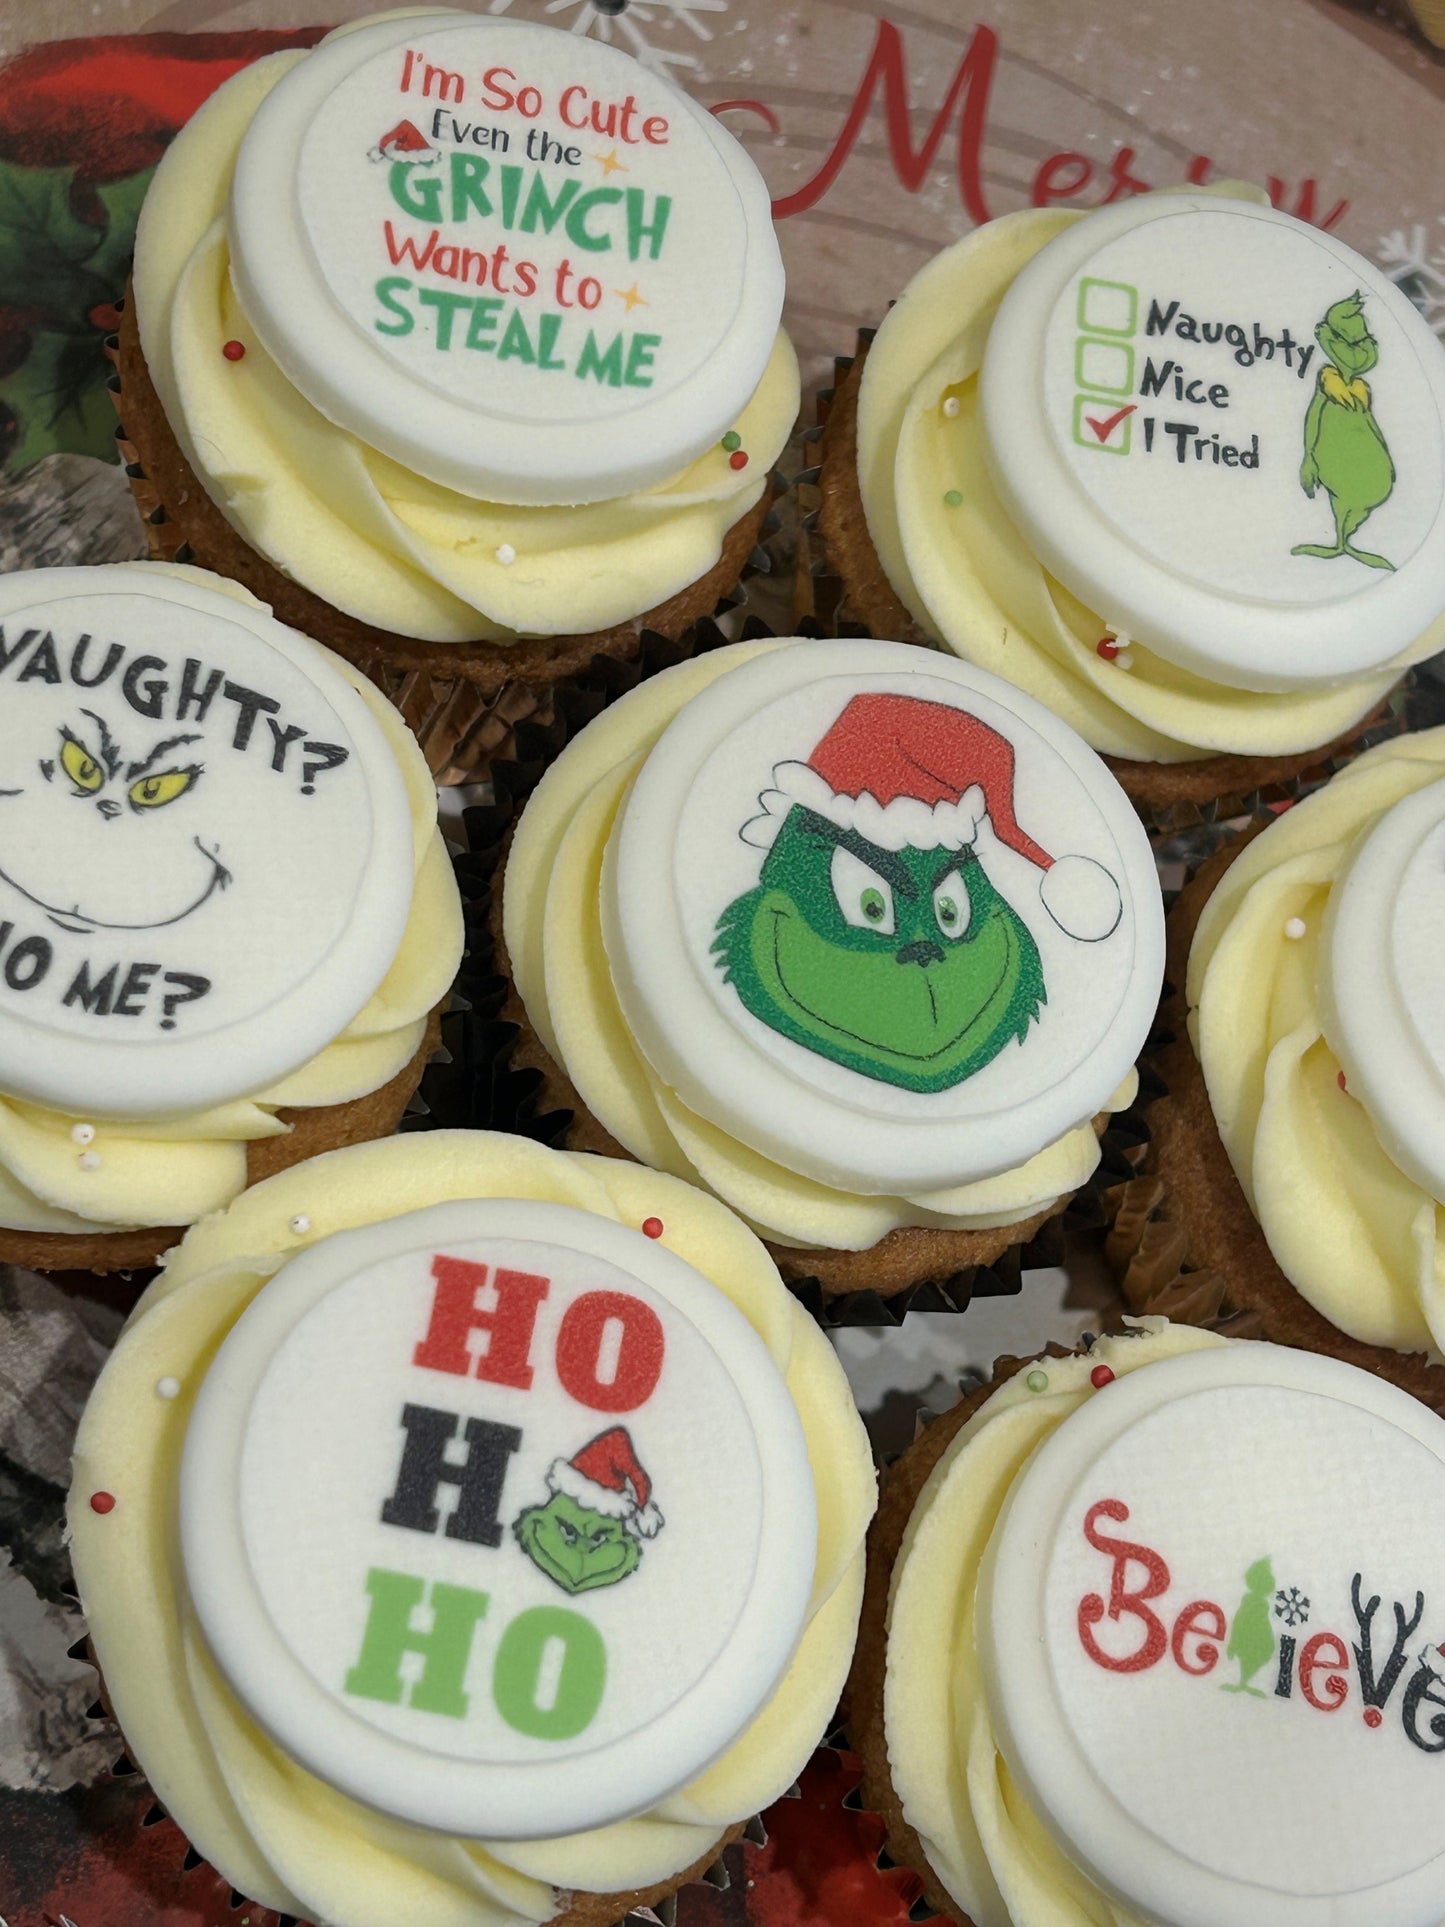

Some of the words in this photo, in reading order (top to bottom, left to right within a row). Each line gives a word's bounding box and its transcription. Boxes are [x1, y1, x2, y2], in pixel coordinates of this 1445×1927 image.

[400, 49, 464, 103] I'm
[481, 66, 543, 118] So
[558, 85, 670, 145] Cute
[431, 108, 510, 152] Even
[526, 128, 582, 166] the
[388, 151, 673, 263] GRINCH
[384, 219, 539, 298] Wants
[555, 258, 603, 310] to
[374, 276, 566, 370] STEAL
[575, 328, 663, 389] ME
[1145, 298, 1315, 379] Naughty
[1139, 356, 1230, 408] Nice
[1143, 417, 1156, 452] I
[1164, 421, 1260, 469] Tried
[62, 959, 212, 1030] ME?
[412, 1254, 665, 1414] HO
[380, 1402, 524, 1549] H
[343, 1566, 608, 1742] HO
